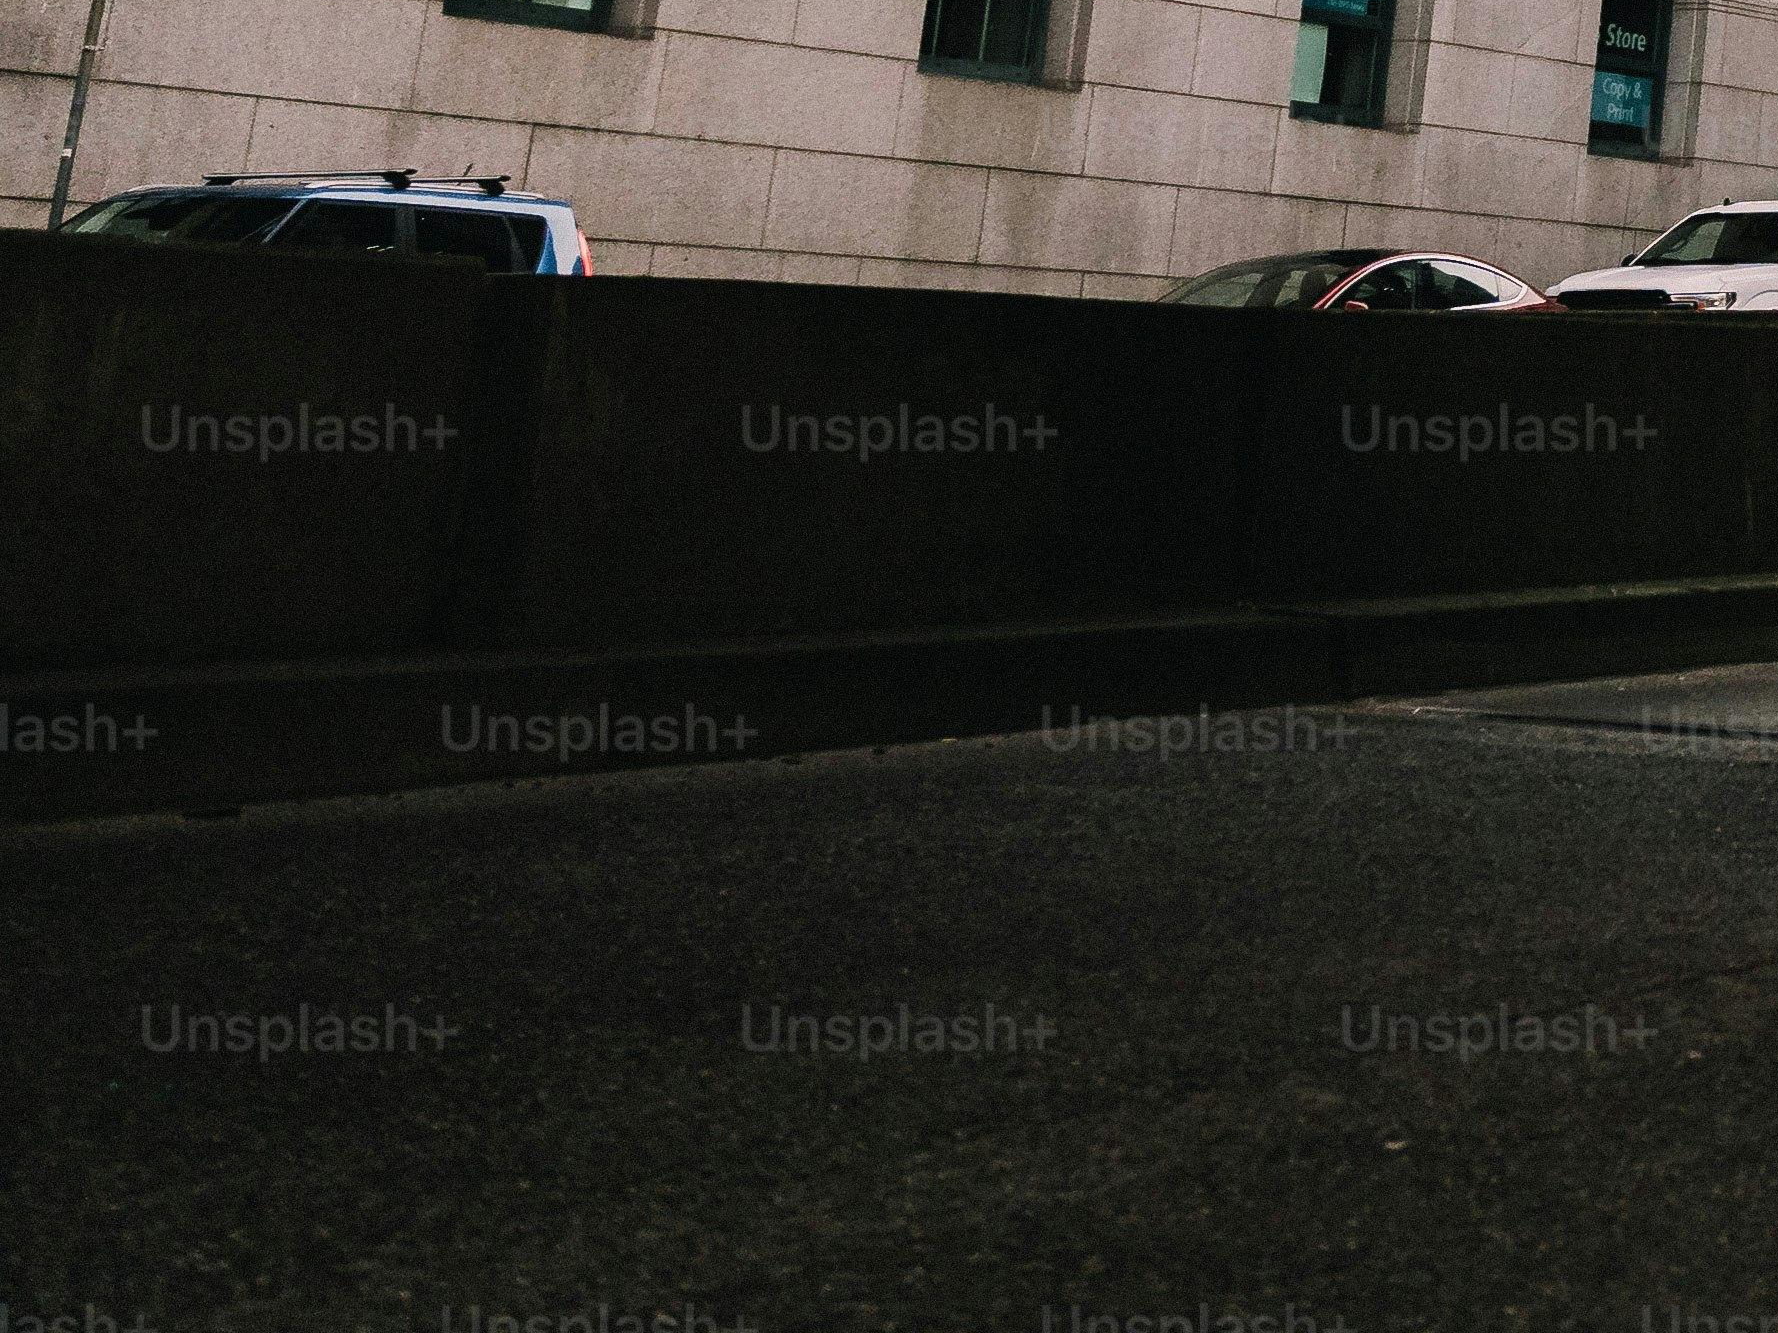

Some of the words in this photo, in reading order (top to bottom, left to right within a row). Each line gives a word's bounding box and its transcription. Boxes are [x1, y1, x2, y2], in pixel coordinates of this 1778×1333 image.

[1605, 23, 1647, 52] Store
[1602, 77, 1632, 101] Copy
[1633, 82, 1642, 99] &
[1606, 103, 1634, 122] Print
